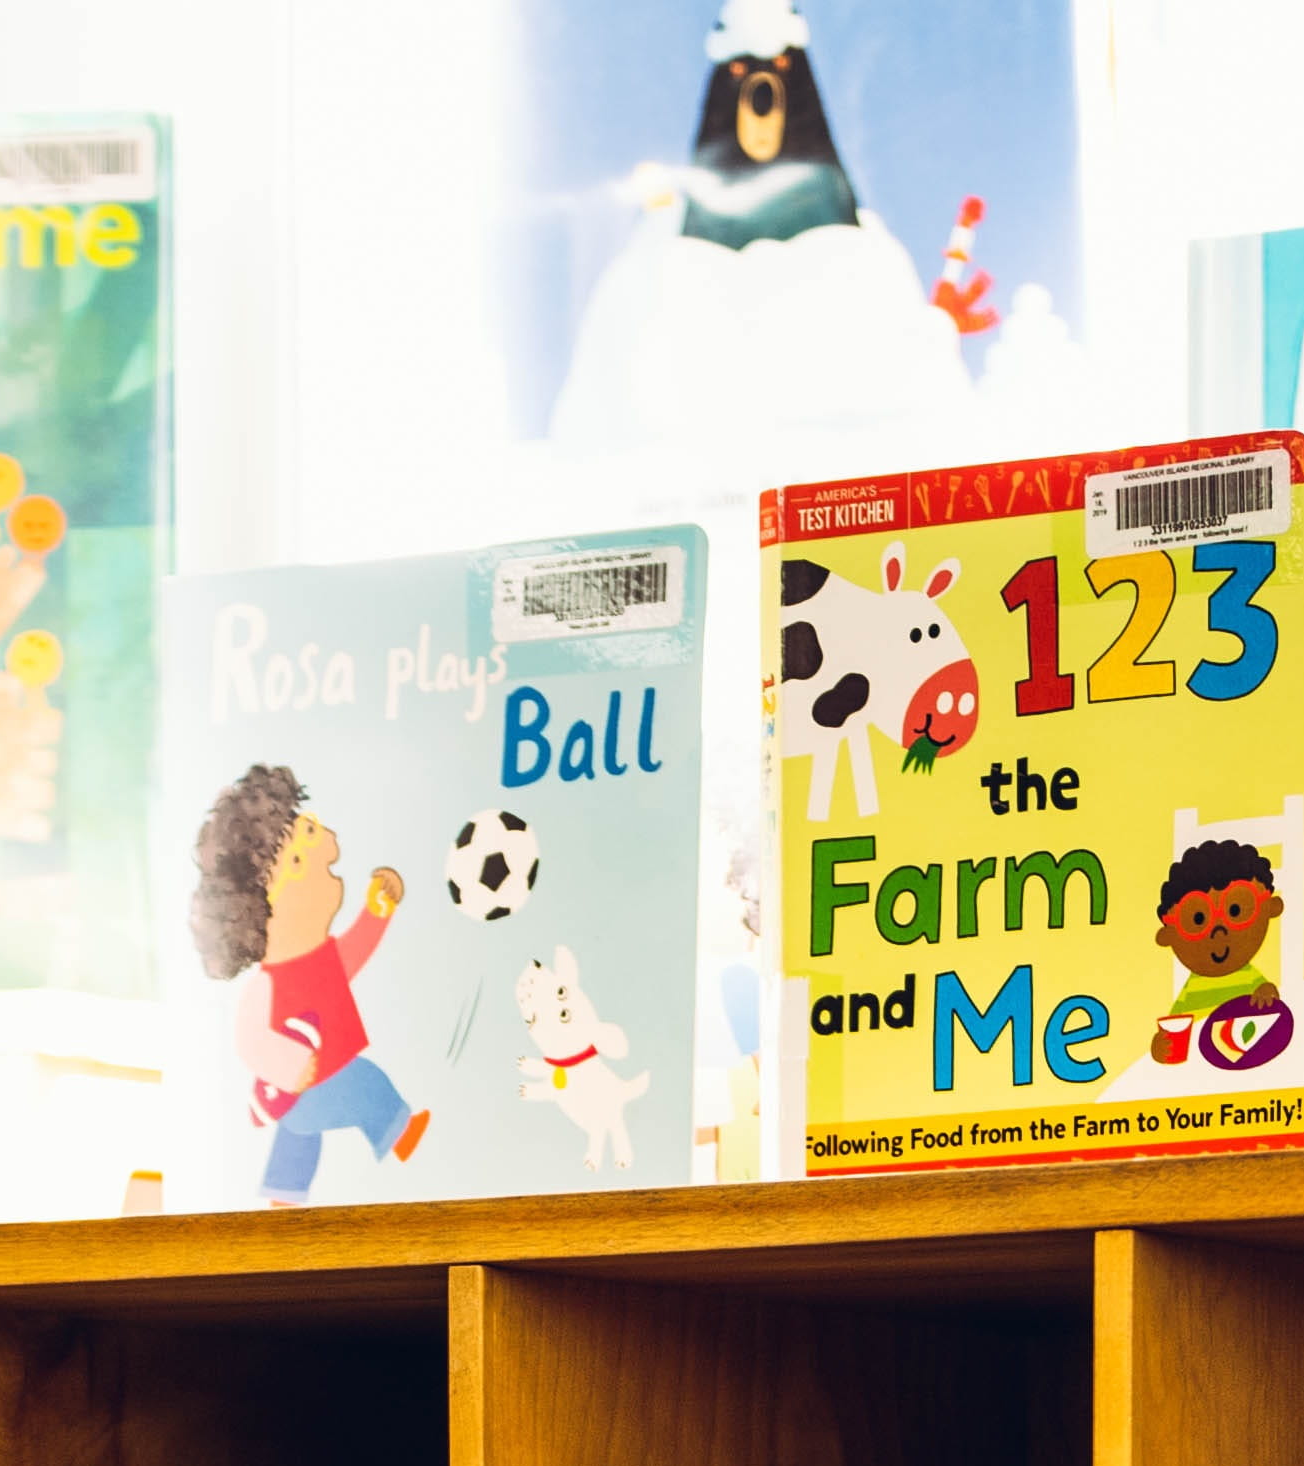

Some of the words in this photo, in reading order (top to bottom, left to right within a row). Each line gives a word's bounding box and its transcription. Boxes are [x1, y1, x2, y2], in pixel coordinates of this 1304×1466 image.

[814, 486, 877, 504] AMERICA'S
[1124, 468, 1165, 481] VANCOUVER
[1166, 466, 1189, 475] ISLAND
[1191, 461, 1224, 471] REGIONAL
[1227, 456, 1255, 466] LIBRARY
[797, 504, 832, 532] TEST
[836, 500, 894, 528] KITCHEN
[212, 603, 355, 723] Rosa
[386, 625, 507, 722] plays
[501, 686, 662, 787] Ball
[981, 756, 1079, 815] the
[809, 834, 1107, 956] Farm
[811, 974, 915, 1036] and
[932, 964, 1109, 1092] Me
[911, 1125, 962, 1150] Food
[971, 1122, 1020, 1145] from
[1030, 1118, 1065, 1141] the
[1072, 1111, 1131, 1138] Farm
[1137, 1113, 1160, 1133] to
[1167, 1106, 1214, 1131] Your
[1220, 1098, 1303, 1129] Family!
